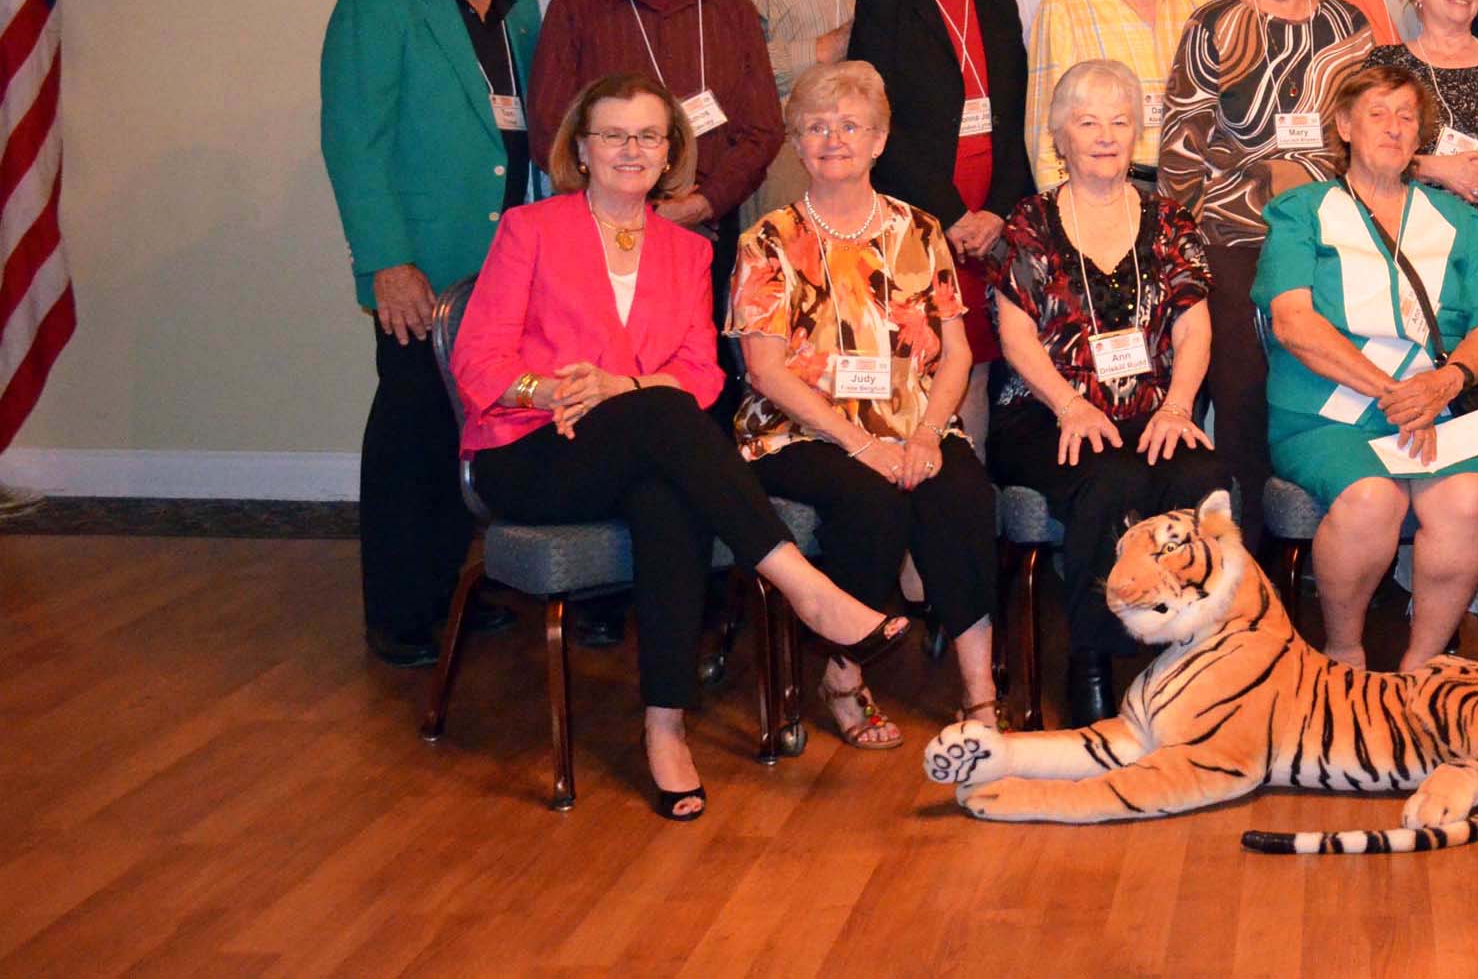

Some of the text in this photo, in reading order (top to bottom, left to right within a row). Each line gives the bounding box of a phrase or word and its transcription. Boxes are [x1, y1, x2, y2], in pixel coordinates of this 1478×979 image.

[1288, 128, 1309, 137] Mary
[1111, 352, 1132, 363] Ann
[850, 374, 876, 385] Judy
